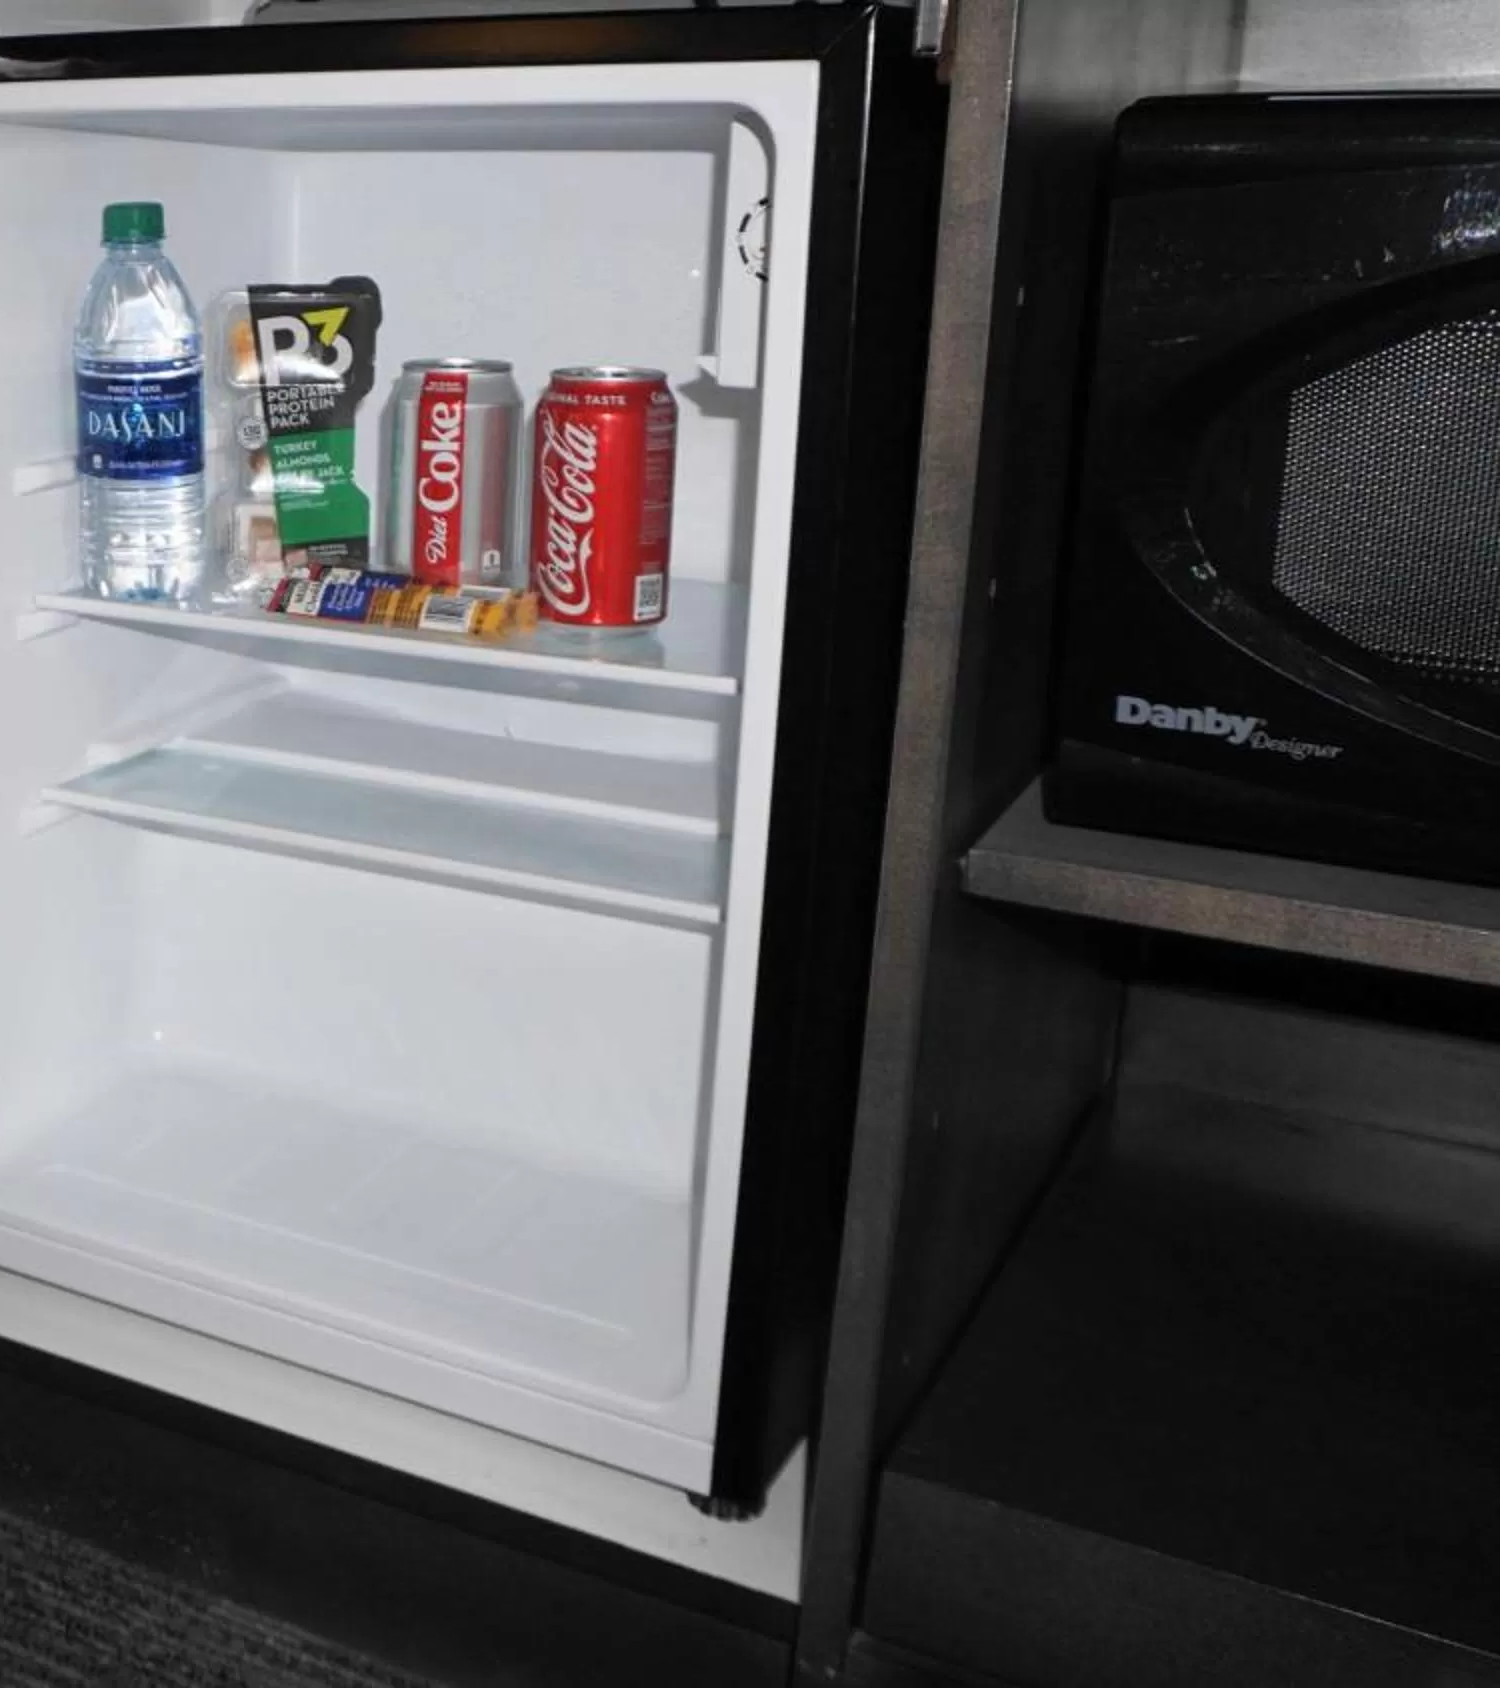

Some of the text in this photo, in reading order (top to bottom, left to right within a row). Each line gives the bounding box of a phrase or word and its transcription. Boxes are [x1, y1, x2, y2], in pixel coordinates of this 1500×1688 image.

[88, 406, 186, 443] DASANI
[269, 397, 336, 415] PROTEIN
[271, 412, 311, 429] PACK
[418, 400, 463, 514] Coke
[425, 515, 449, 565] Diet
[1115, 695, 1258, 745] Danby
[1251, 731, 1345, 760] Designer
